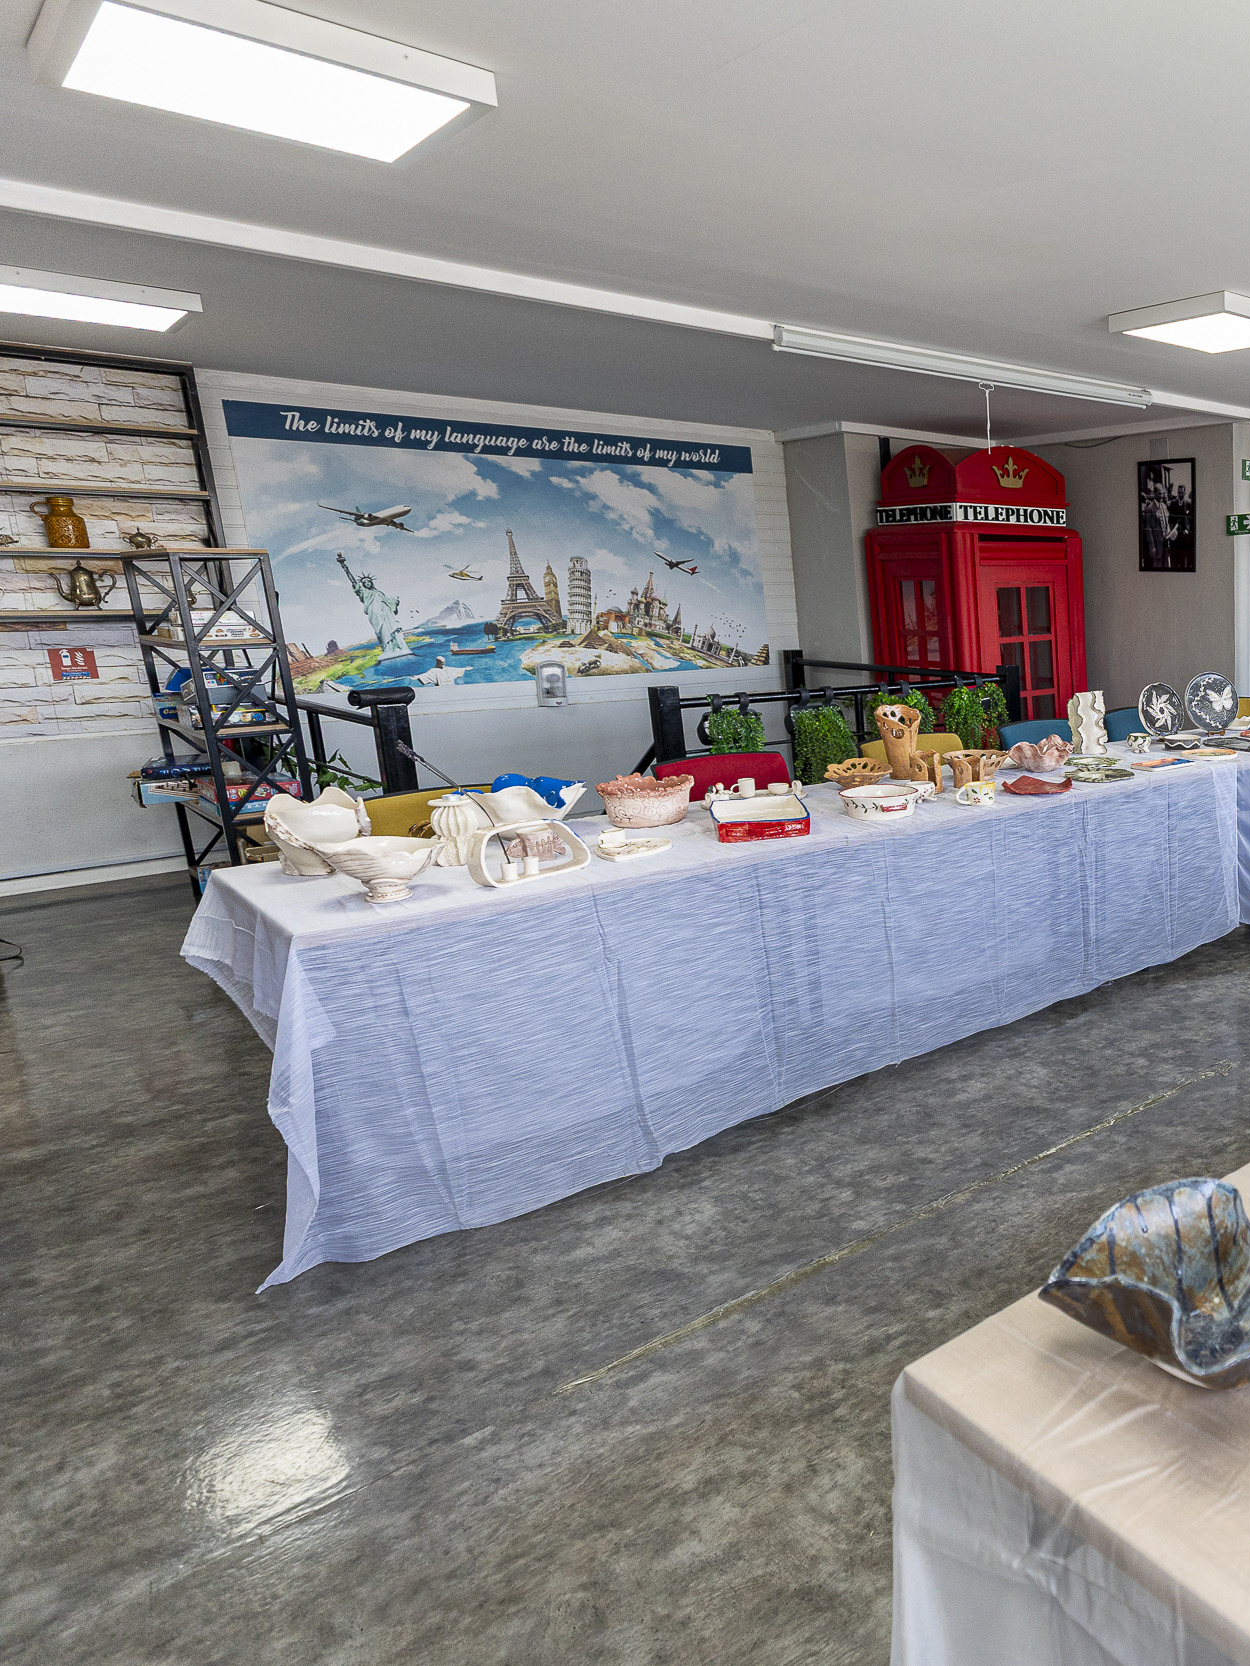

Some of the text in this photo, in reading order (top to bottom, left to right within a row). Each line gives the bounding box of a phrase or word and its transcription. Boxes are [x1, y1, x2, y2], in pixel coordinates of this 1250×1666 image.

[280, 411, 721, 467] The limits of my language are the limits of my world
[877, 504, 952, 524] TELEPHONE
[958, 504, 1066, 526] TELEPHONE
